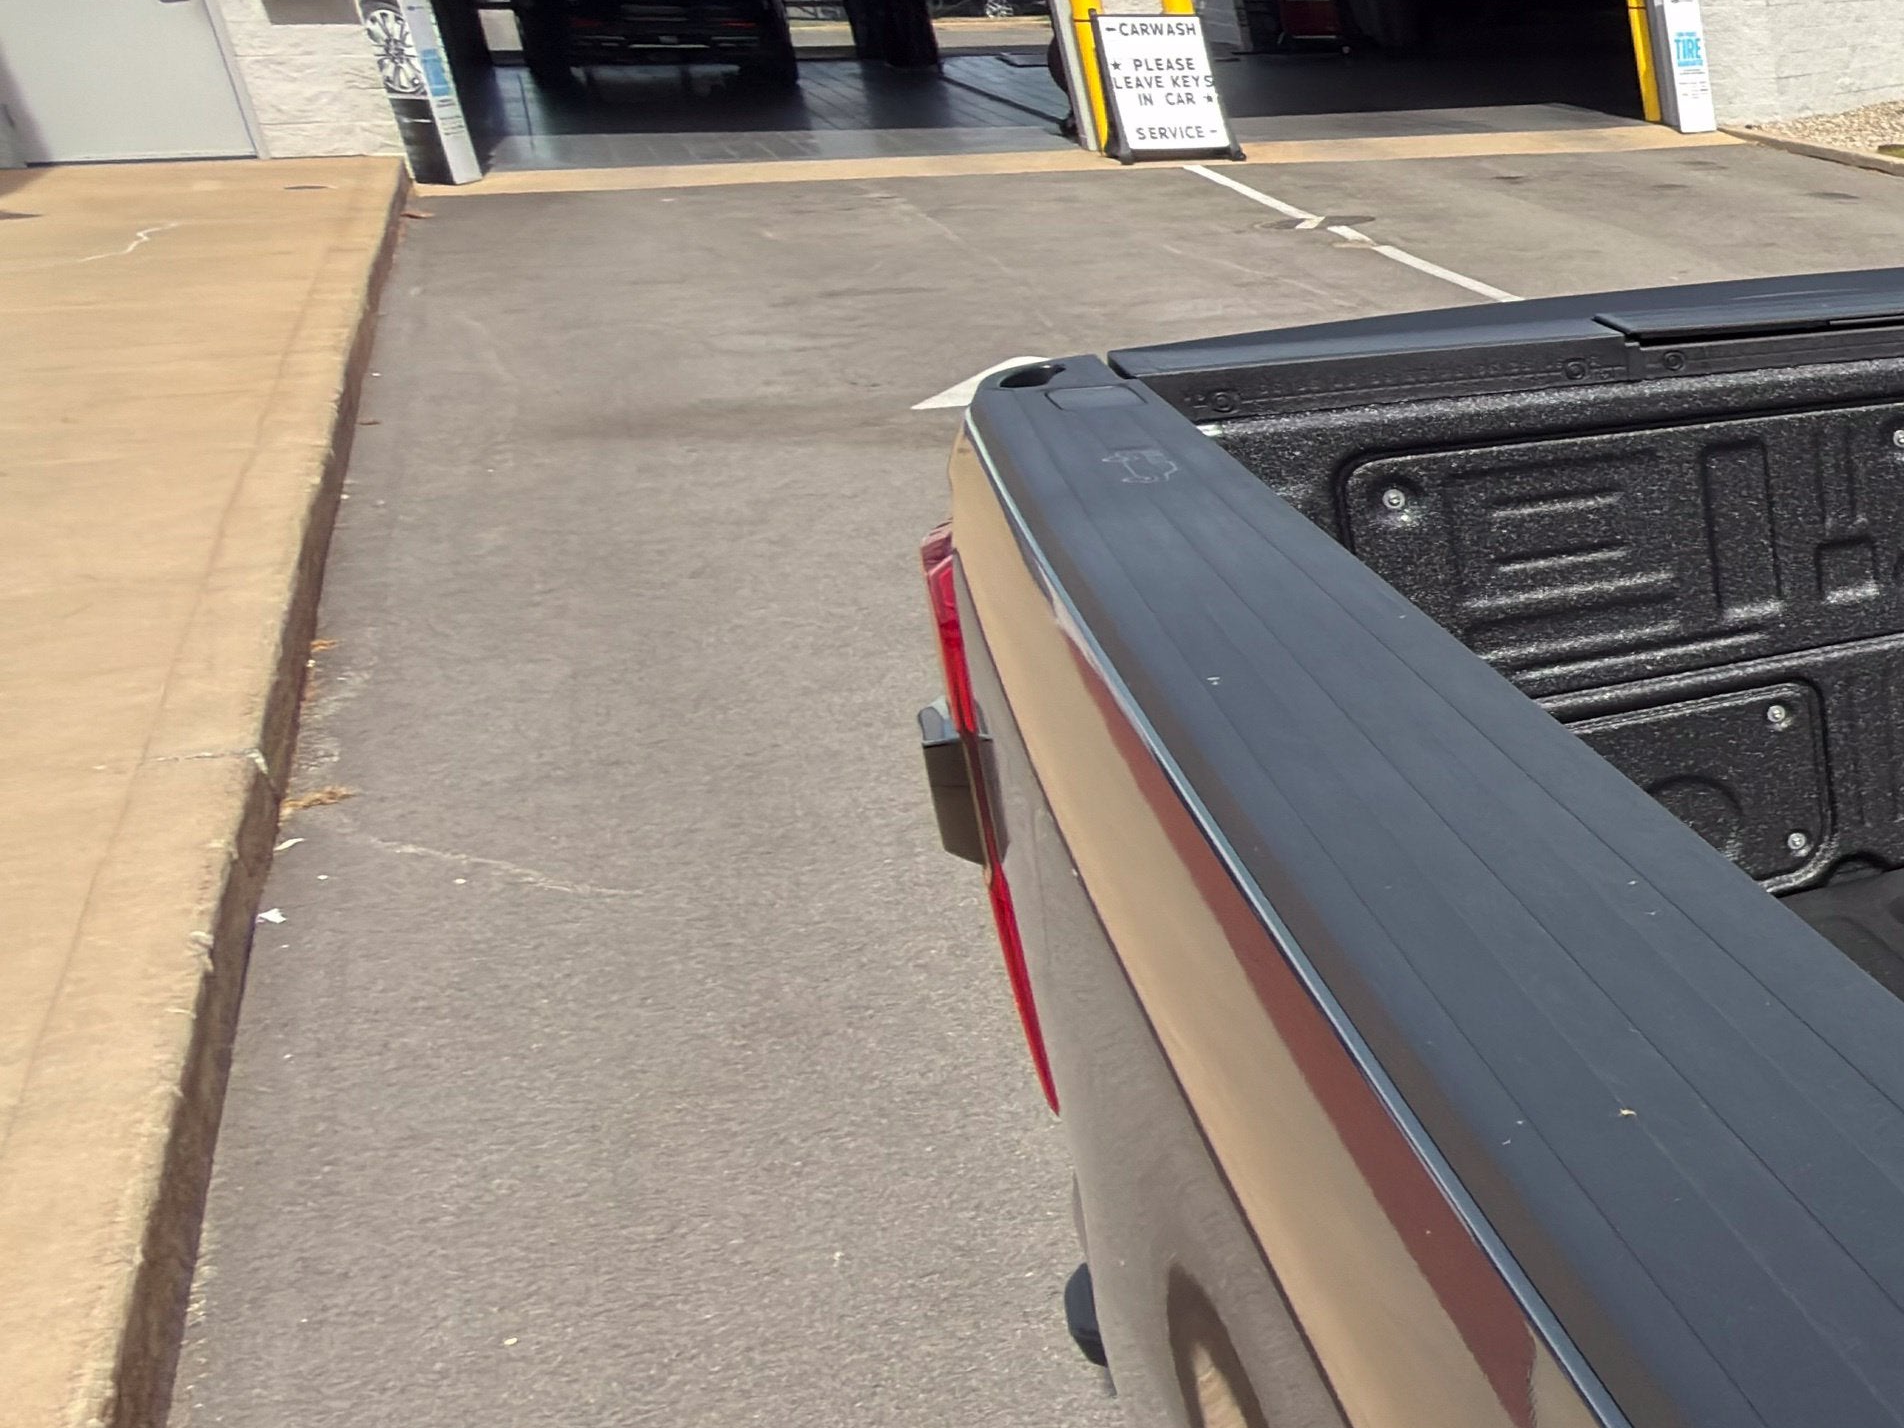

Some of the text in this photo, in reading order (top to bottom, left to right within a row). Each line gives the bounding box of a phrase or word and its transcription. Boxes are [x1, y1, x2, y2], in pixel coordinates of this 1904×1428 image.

[1119, 22, 1197, 36] CARWASH
[1674, 38, 1702, 60] TIRE
[1132, 57, 1196, 71] PLEASE
[1112, 74, 1216, 89] LEAVE KEYS
[1138, 92, 1196, 106] IN CAR
[1136, 125, 1206, 140] SERVICE
